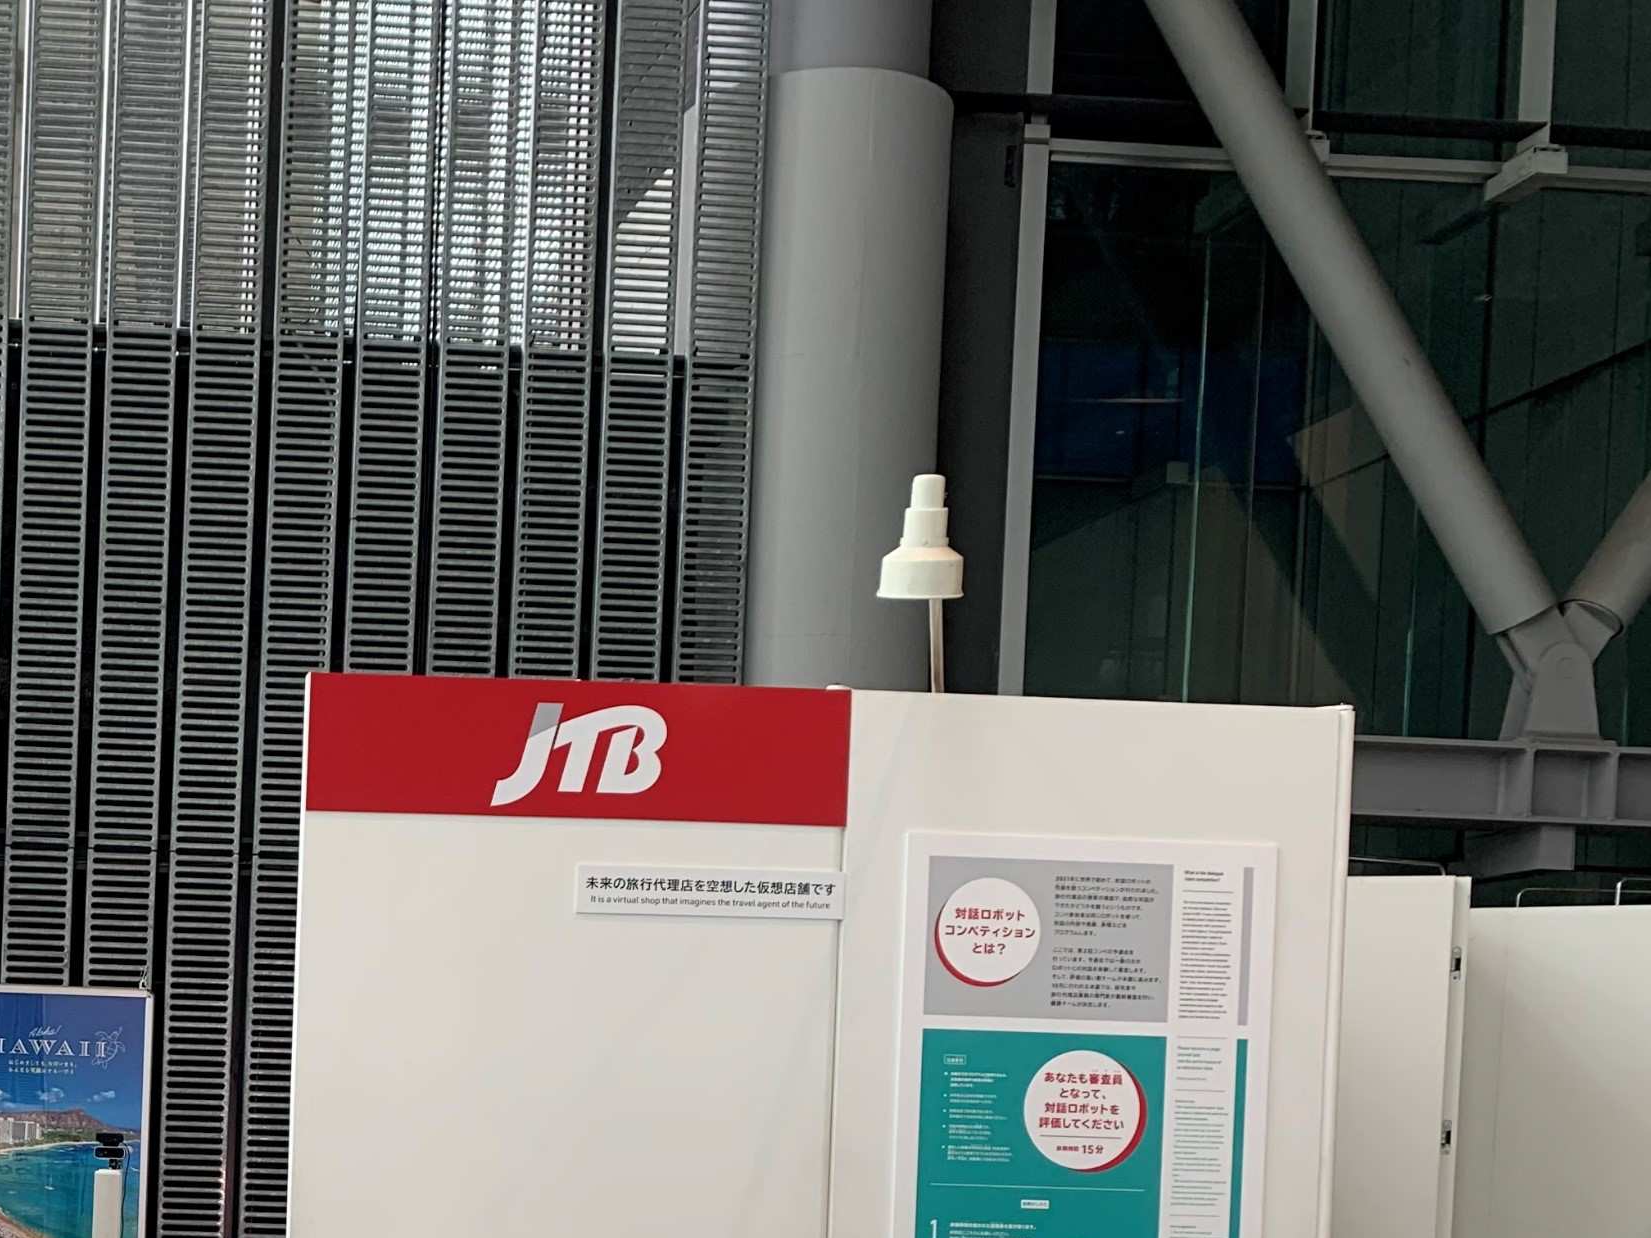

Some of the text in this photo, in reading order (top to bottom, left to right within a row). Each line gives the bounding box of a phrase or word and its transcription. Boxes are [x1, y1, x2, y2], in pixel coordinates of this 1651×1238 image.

[490, 703, 668, 807] JTB
[585, 876, 837, 897] 未来の旅行代理店を空想した仮想店舗です
[613, 895, 638, 904] virtual
[641, 896, 661, 907] shop
[662, 896, 678, 906] that
[680, 897, 716, 908] imagines
[718, 898, 731, 907] the
[733, 898, 756, 908] travel
[757, 900, 780, 910] agent
[781, 900, 790, 909] of
[791, 900, 804, 909] the
[806, 901, 830, 910] future
[953, 906, 1026, 923] 対話ロボット
[944, 923, 1036, 941] コンペティション
[971, 942, 1008, 956] とは?
[1044, 1071, 1124, 1086] あなたも審査員
[1059, 1088, 1107, 1100] となって、
[1044, 1102, 1120, 1115] 対話ロボットを
[1038, 1117, 1124, 1130] 評価してください
